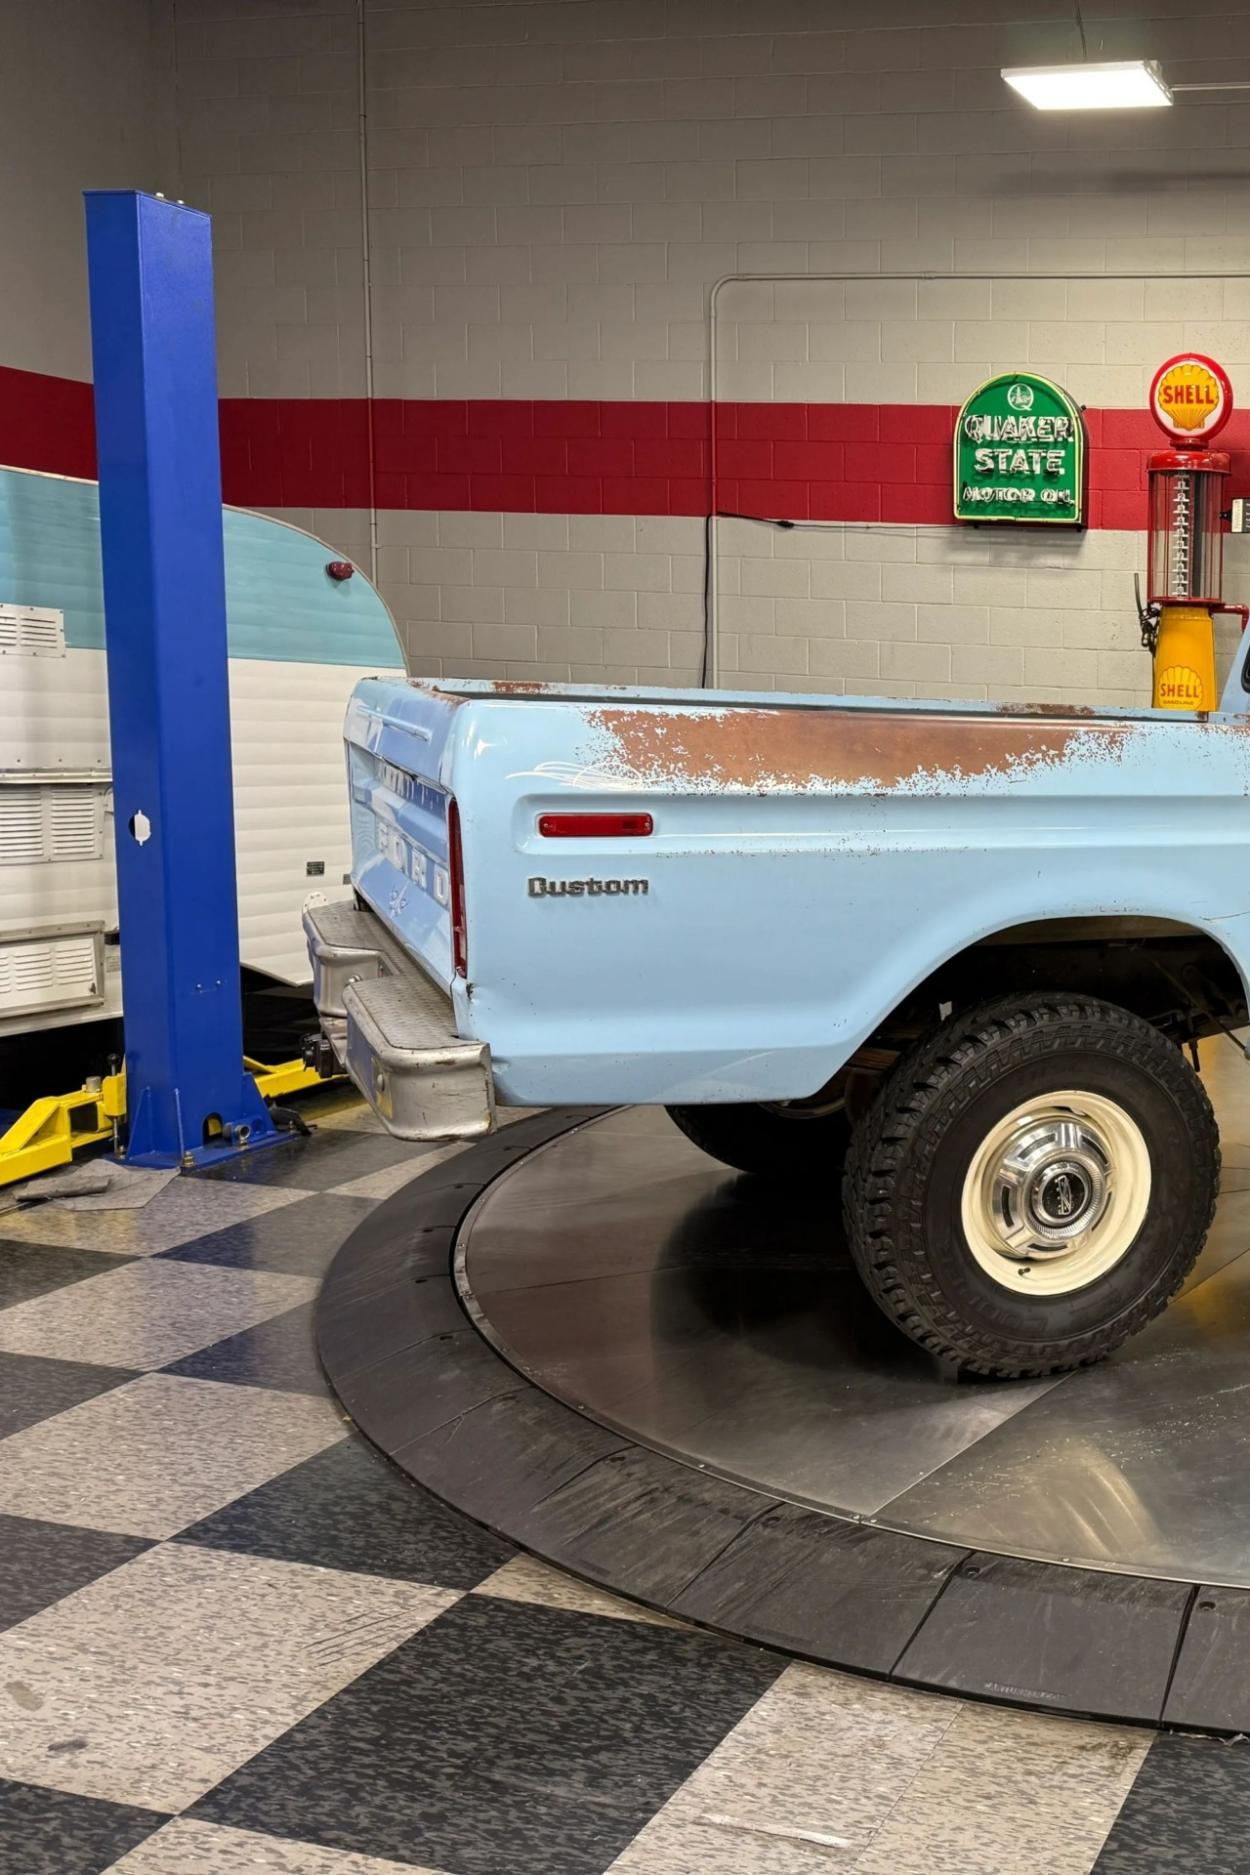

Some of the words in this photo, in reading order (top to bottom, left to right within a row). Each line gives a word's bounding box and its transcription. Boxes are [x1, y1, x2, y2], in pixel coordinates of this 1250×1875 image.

[1162, 385, 1215, 405] SHELL
[964, 414, 1075, 443] QUAKER
[974, 447, 1066, 475] STATE
[962, 487, 1036, 502] MOTOR
[1040, 488, 1075, 504] OIL
[1160, 683, 1200, 698] SHELL
[527, 877, 649, 898] Custom
